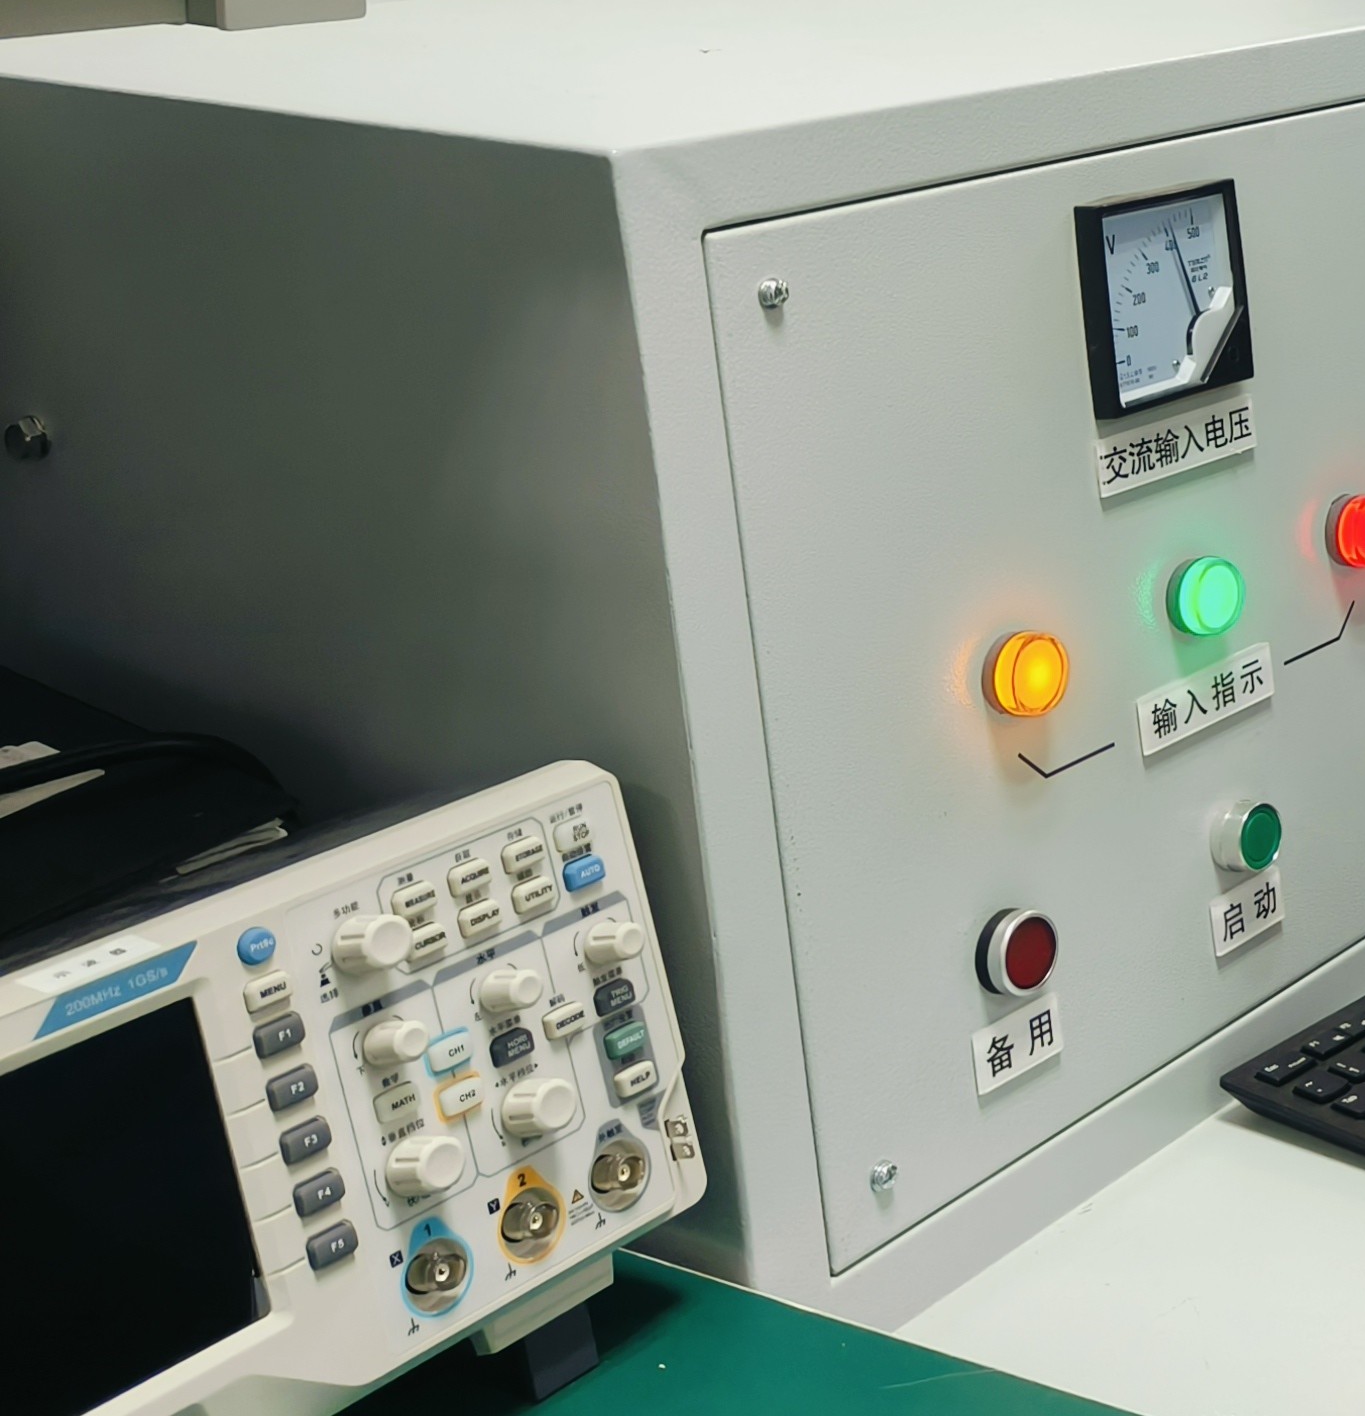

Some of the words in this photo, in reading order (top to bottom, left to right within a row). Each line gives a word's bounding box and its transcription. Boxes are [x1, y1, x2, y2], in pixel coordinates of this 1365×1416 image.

[1186, 226, 1200, 240] 500
[1105, 234, 1115, 255] V
[1146, 261, 1160, 275] 300
[1132, 292, 1146, 306] 200
[1126, 325, 1139, 339] 100
[1126, 355, 1132, 366] 0
[1105, 407, 1253, 485] 交流输入电压
[1151, 658, 1265, 739] 输入指示
[581, 864, 600, 878] AUTO
[524, 885, 553, 902] UTILITY
[470, 908, 500, 926] DISPLAY
[1222, 881, 1278, 942] 启动
[260, 981, 287, 999] MENU
[65, 987, 122, 1016] 200MHz
[278, 1028, 292, 1042] F1
[617, 1030, 645, 1050] DEFAULT
[985, 1008, 1055, 1078] 备用
[448, 1044, 465, 1057] CH1
[630, 1070, 651, 1087] HELP
[290, 1080, 306, 1094] F2
[391, 1093, 416, 1111] MATH
[459, 1089, 476, 1103] CH2
[304, 1133, 318, 1147] F3
[517, 1173, 527, 1187] 2
[317, 1185, 332, 1200] F4
[490, 1199, 499, 1212] Y
[424, 1223, 432, 1237] 1
[330, 1239, 345, 1253] F5
[393, 1253, 401, 1266] X
